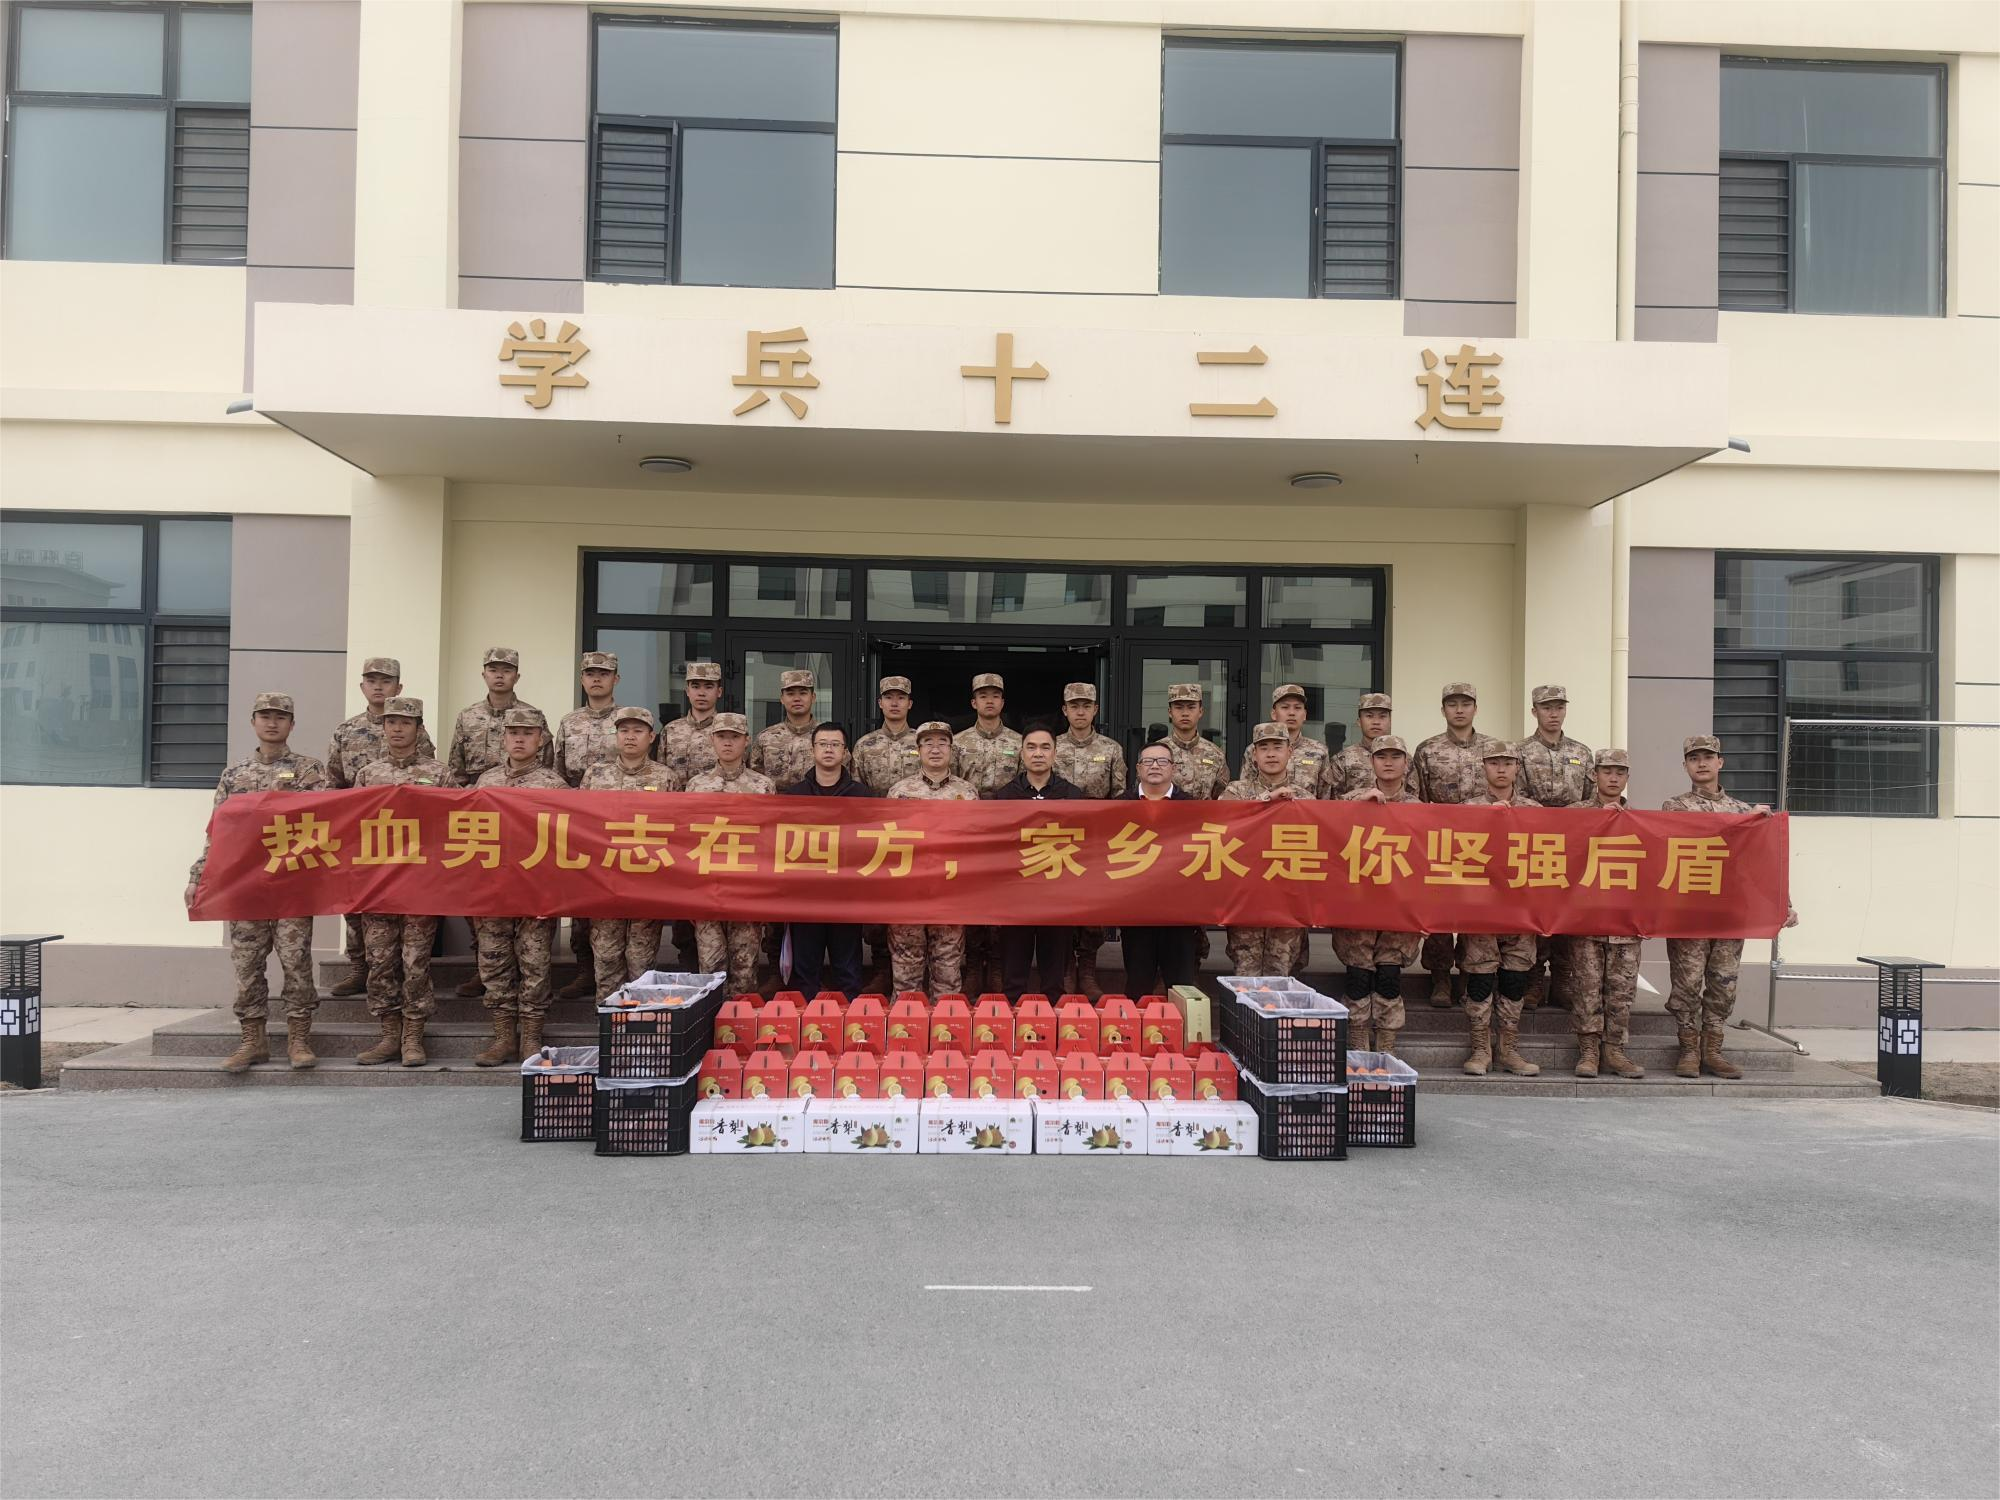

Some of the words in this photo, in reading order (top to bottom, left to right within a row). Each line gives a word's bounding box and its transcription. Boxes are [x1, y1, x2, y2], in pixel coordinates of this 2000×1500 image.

[500, 318, 1504, 431] 学兵十二连
